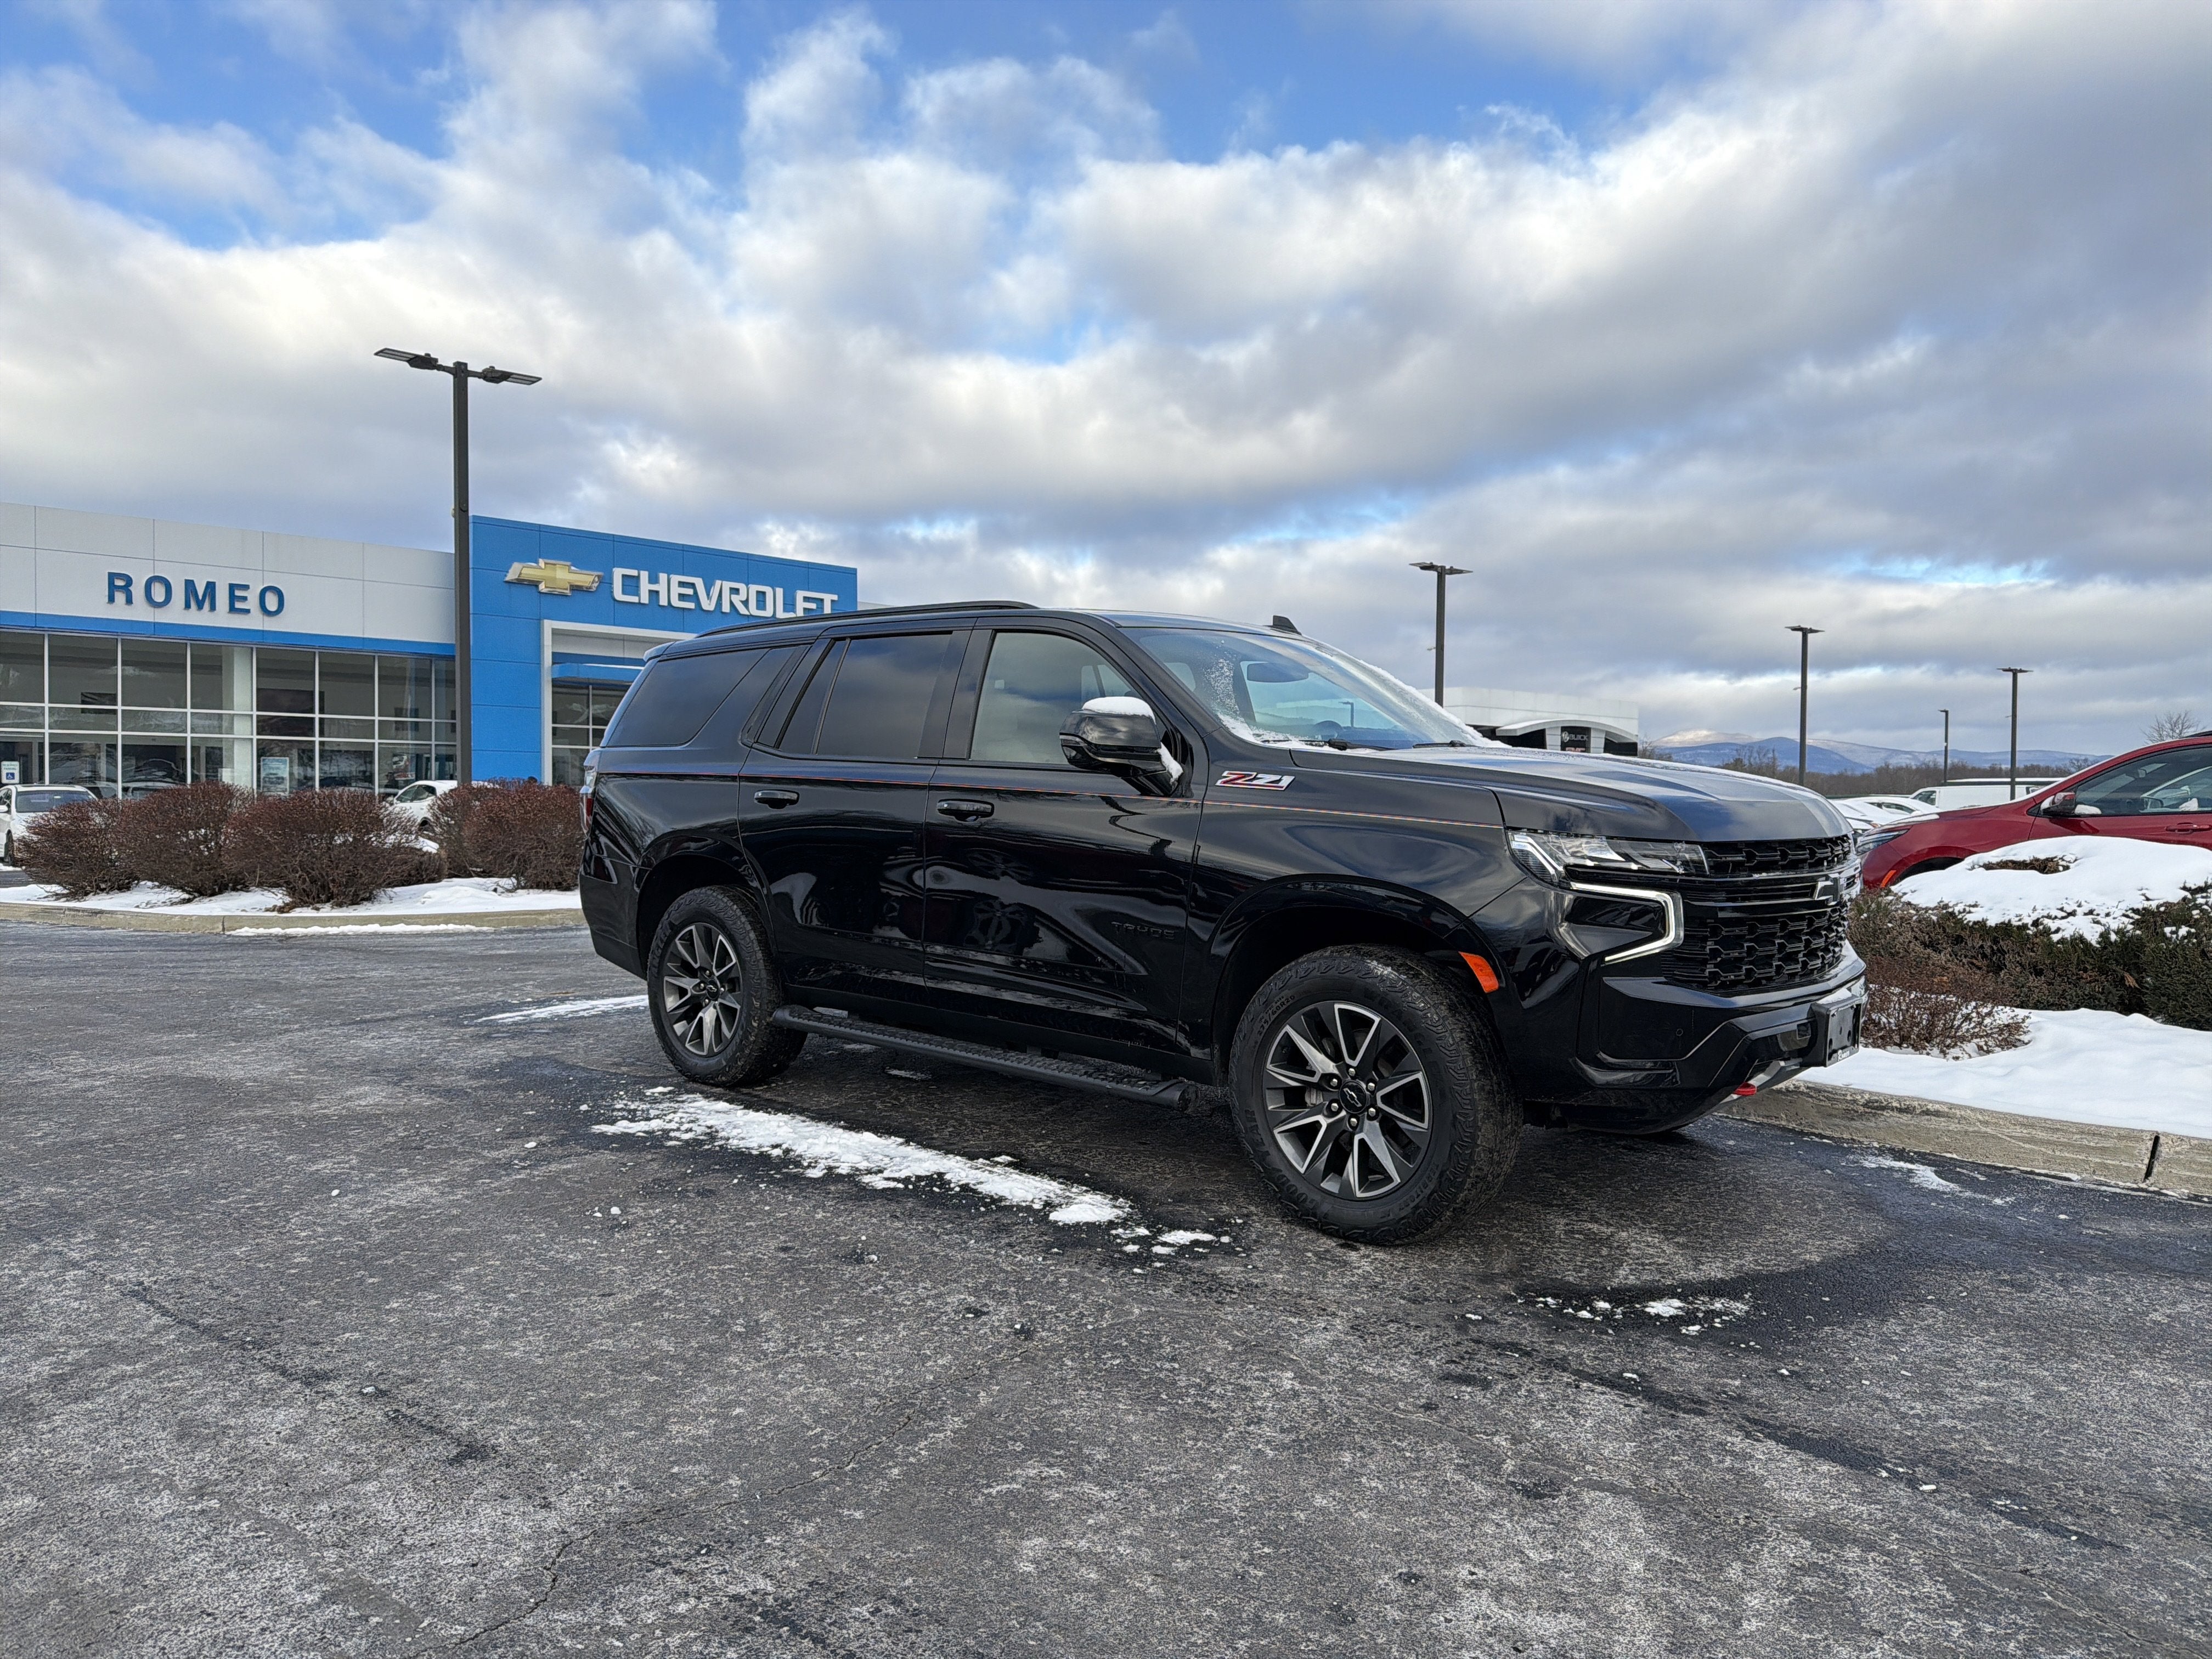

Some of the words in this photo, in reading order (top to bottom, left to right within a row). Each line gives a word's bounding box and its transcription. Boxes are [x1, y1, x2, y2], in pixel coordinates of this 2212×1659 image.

[107, 572, 285, 617] ROMEO
[612, 567, 838, 618] CHEVROLET
[1215, 770, 1295, 791] Z71
[1257, 995, 1295, 1037] 275/60R20
